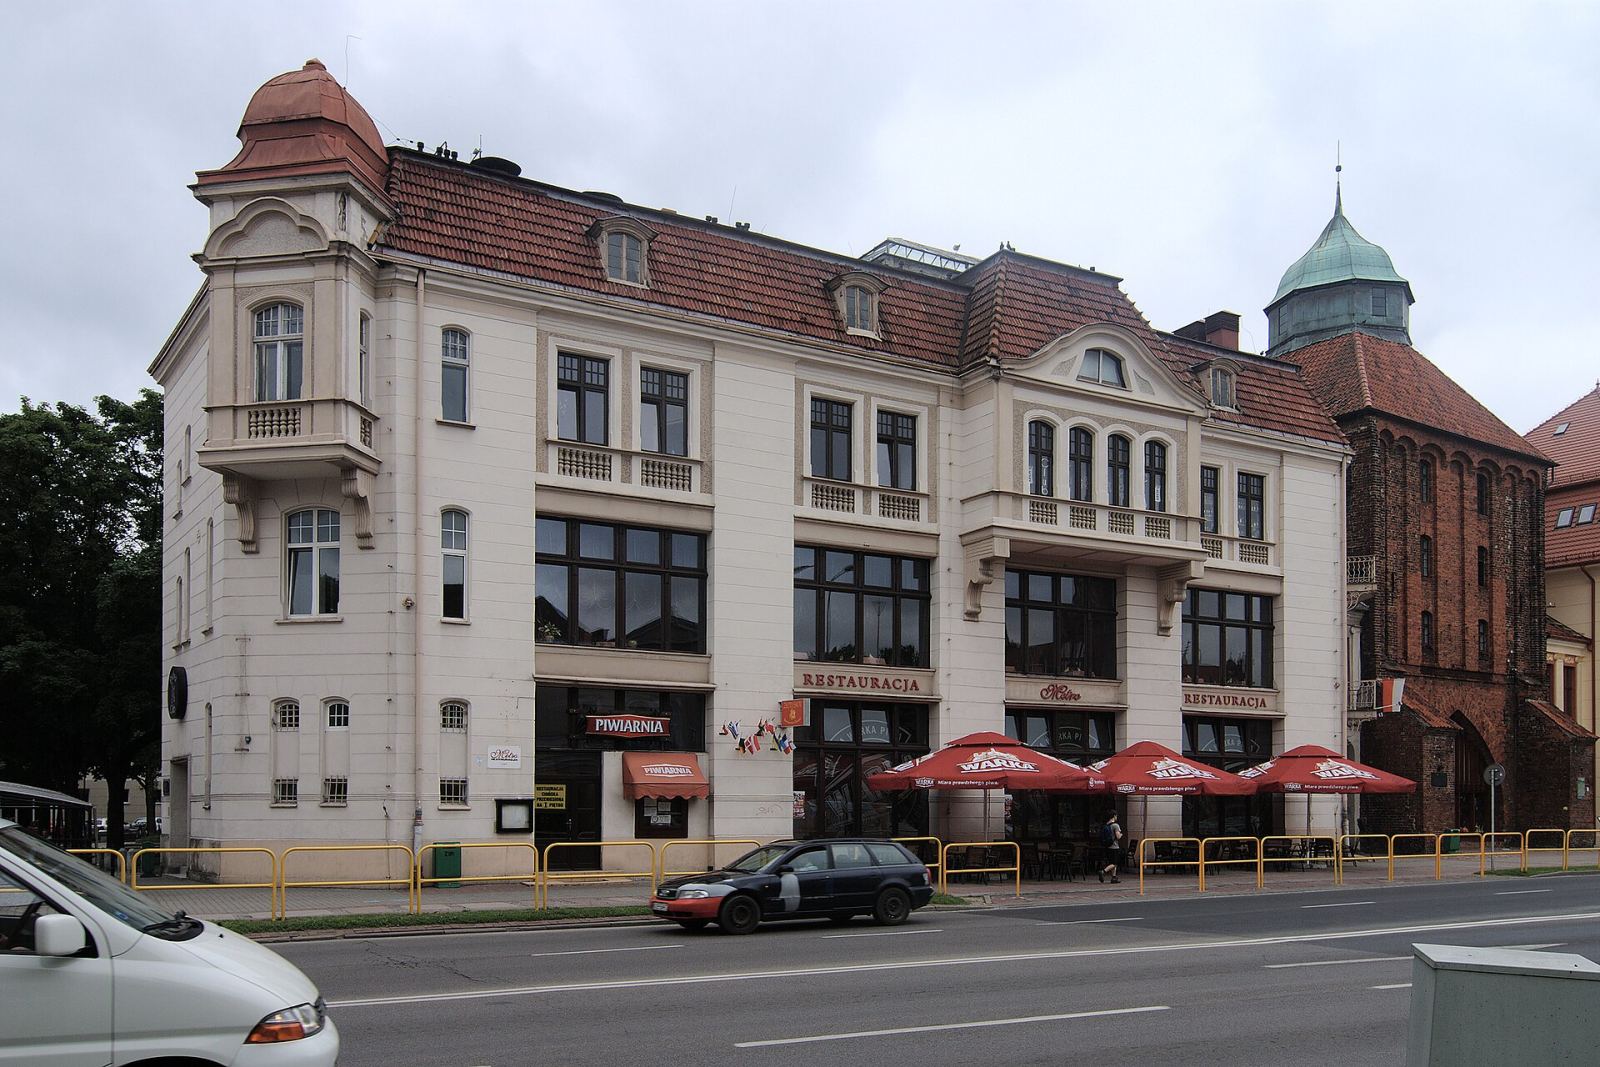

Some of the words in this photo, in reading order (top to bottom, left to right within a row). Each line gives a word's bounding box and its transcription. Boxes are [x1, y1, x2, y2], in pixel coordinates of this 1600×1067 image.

[803, 673, 920, 693] RESTAURACJA
[1040, 683, 1082, 701] Metro
[1183, 693, 1267, 709] RESTAURACJA
[595, 718, 664, 733] PIWIARNIA
[643, 766, 693, 775] PIWIARNIA
[960, 758, 1035, 771] WARKA
